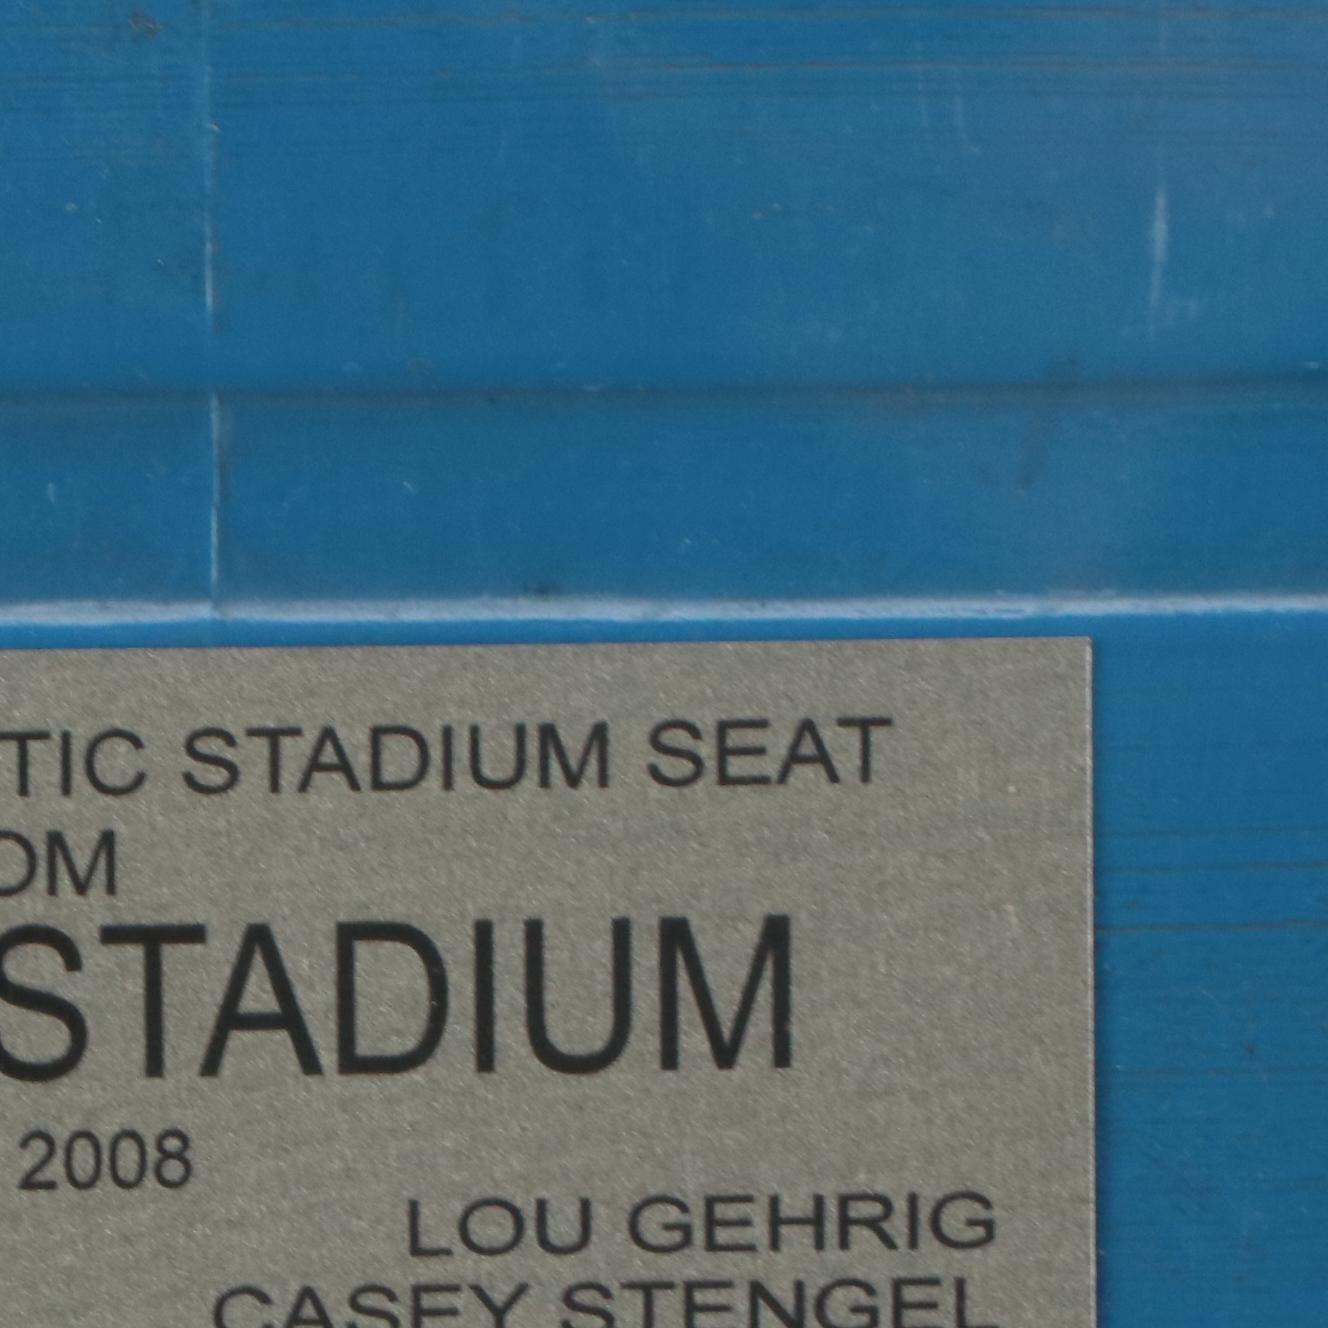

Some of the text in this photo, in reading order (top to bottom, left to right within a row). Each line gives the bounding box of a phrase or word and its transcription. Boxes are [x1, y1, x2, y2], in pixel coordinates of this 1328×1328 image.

[182, 721, 610, 797] STADIUM
[647, 715, 894, 789] SEAT
[18, 1127, 194, 1192] 2008
[407, 1189, 996, 1259] LOU GEHRIG
